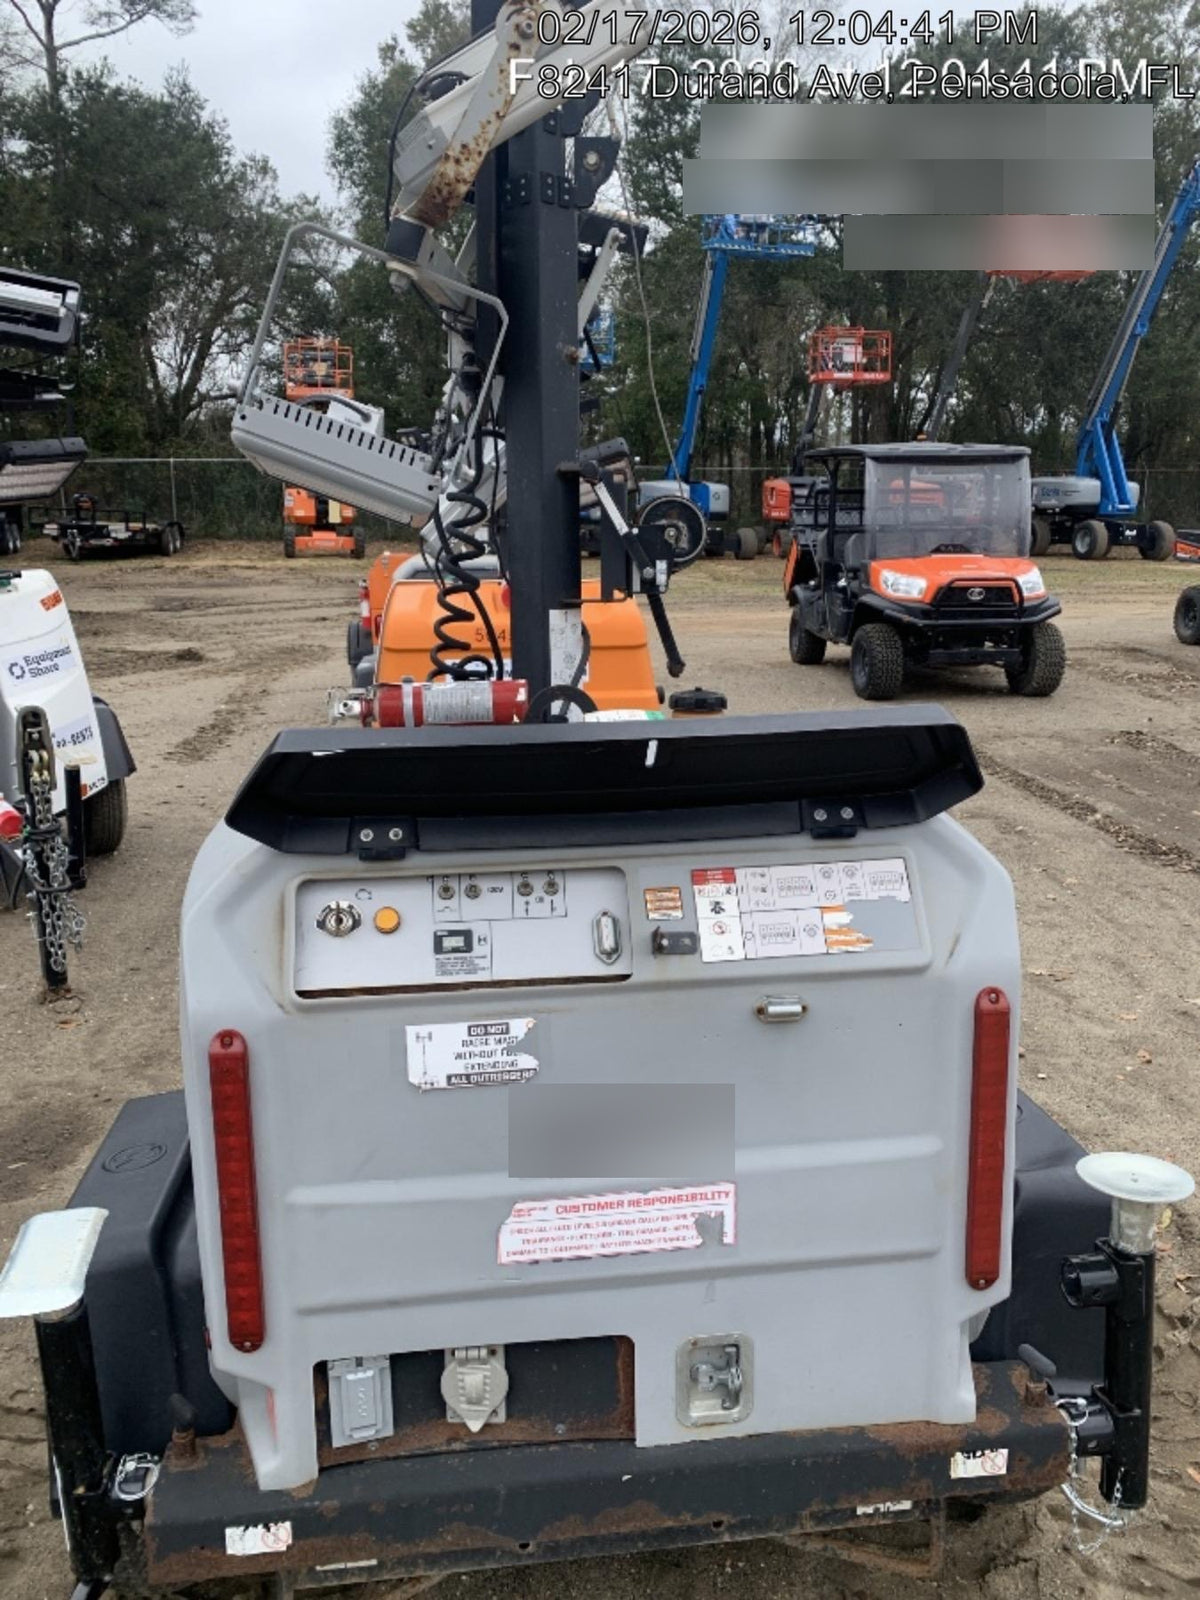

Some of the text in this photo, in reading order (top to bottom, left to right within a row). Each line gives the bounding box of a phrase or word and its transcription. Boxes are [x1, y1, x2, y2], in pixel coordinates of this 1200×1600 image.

[28, 662, 60, 678] Share
[470, 1024, 508, 1036] DO NOT
[555, 1199, 625, 1215] CUSTOMER
[627, 1190, 732, 1207] RESPONSIBILITY
